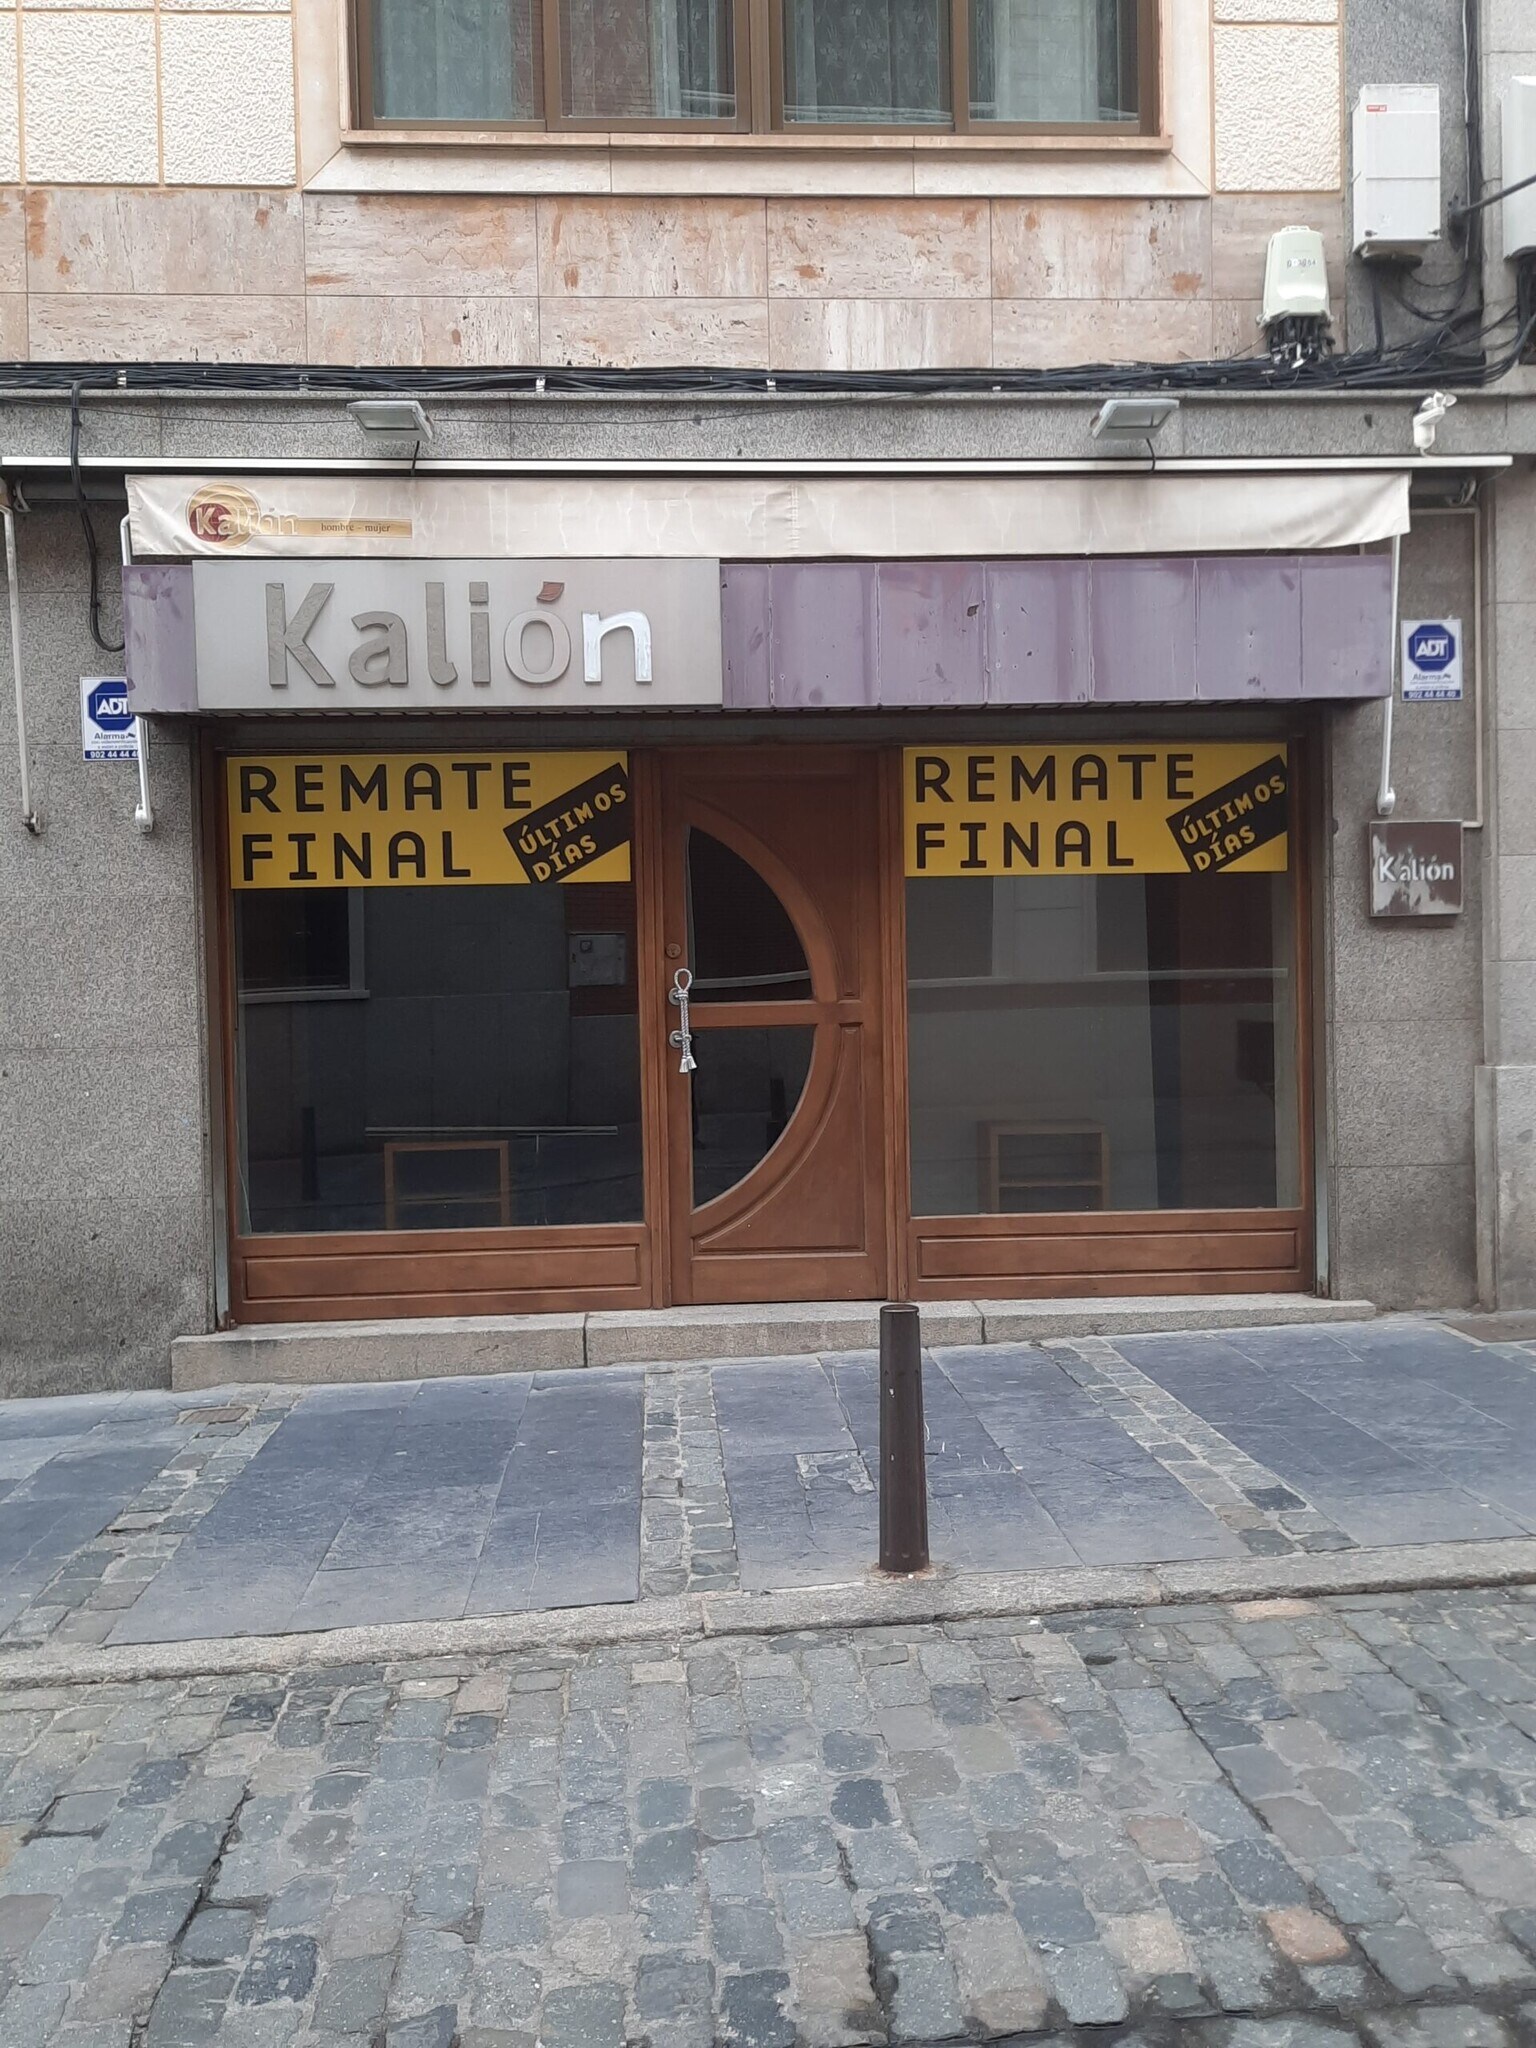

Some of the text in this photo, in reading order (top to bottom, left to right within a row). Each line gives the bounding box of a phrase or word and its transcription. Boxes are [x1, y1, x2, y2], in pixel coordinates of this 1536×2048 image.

[195, 507, 299, 536] Kalión
[321, 523, 354, 532] hombre
[364, 523, 391, 533] mujer
[265, 581, 652, 687] Kalión
[1416, 639, 1449, 657] ADT
[96, 697, 128, 715] ADT
[90, 751, 105, 759] 902
[107, 750, 118, 758] 44
[119, 750, 130, 758] 44
[94, 732, 126, 740] Alarma
[239, 762, 532, 813] REMATE
[915, 754, 1194, 803] REMATE
[518, 783, 627, 854] ÚLTIMOS
[1180, 775, 1286, 844] ÚLTIMOS
[242, 830, 472, 881] FINAL
[532, 834, 597, 882] DÍAS
[916, 820, 1134, 869] FINAL
[1193, 825, 1256, 872] DÍAS
[1379, 854, 1454, 882] Kalión
